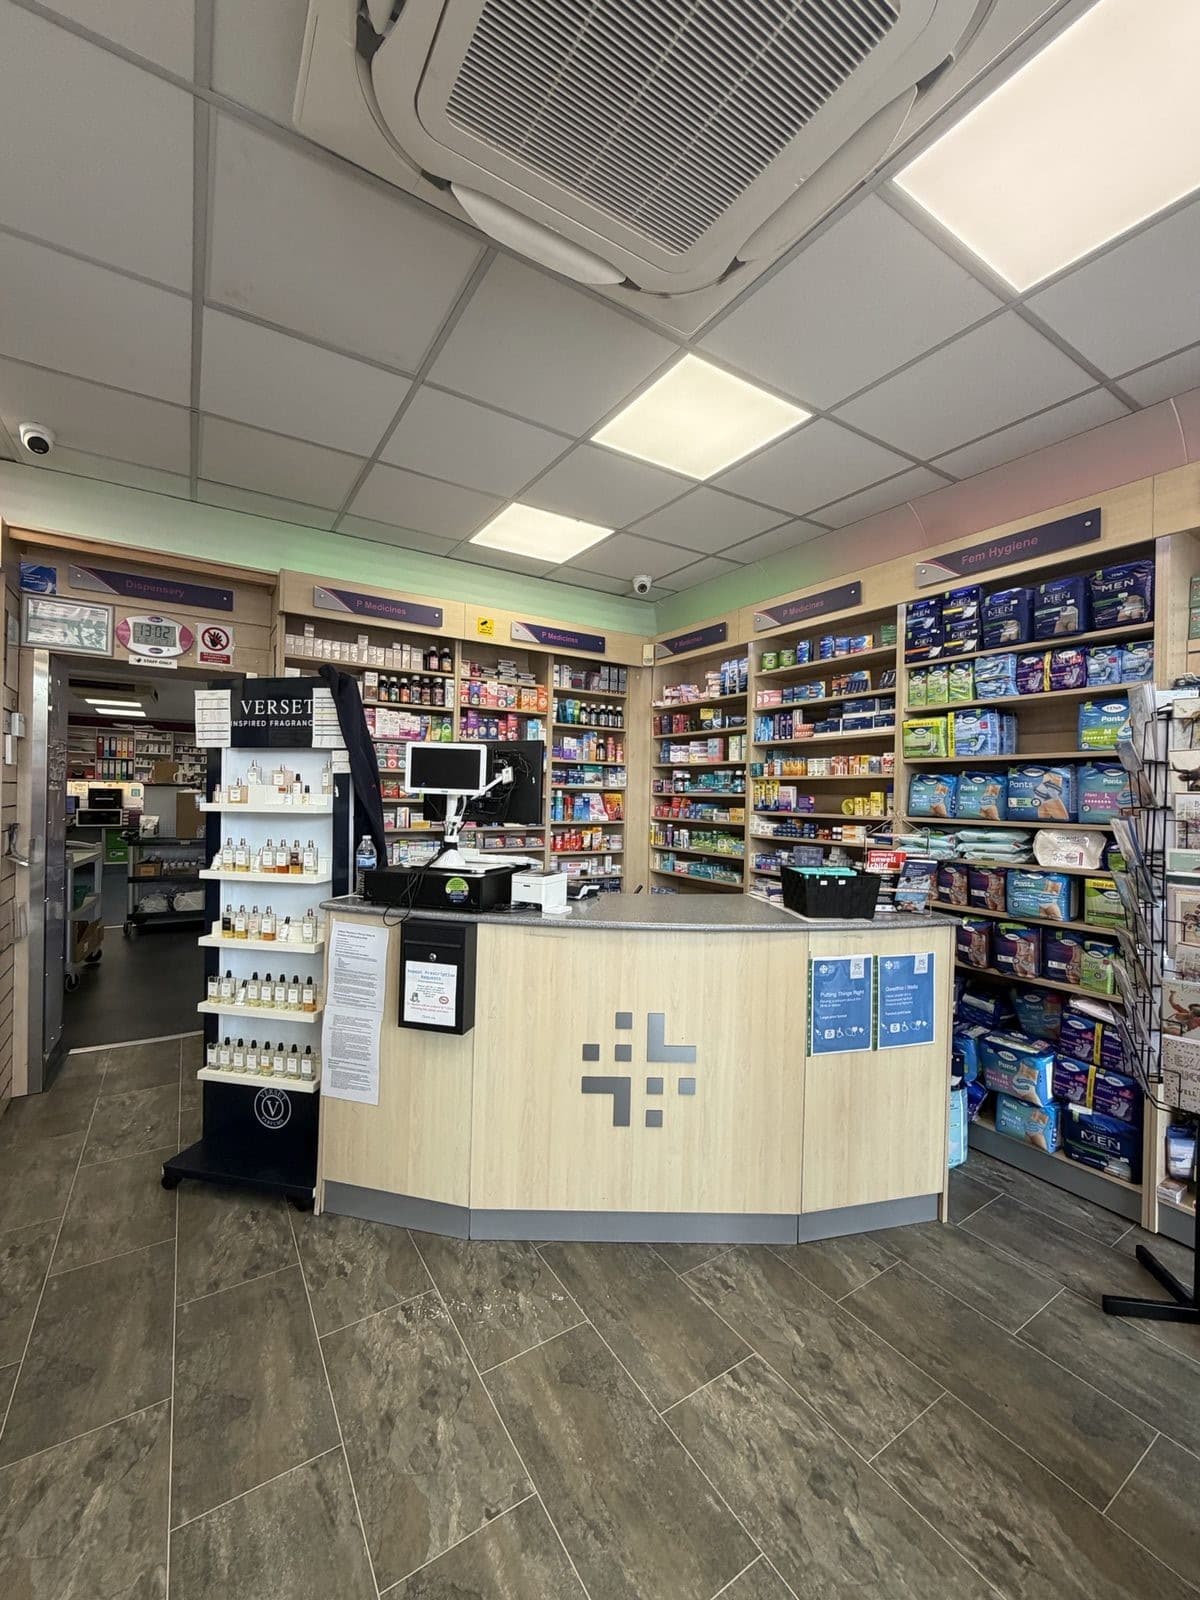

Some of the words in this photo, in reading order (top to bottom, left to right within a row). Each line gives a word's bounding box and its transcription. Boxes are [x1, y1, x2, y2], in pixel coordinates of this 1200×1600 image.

[961, 552, 985, 565] Fem
[988, 537, 1039, 558] Hygiene
[1101, 578, 1134, 592] MEN
[1043, 592, 1071, 604] MEN
[356, 599, 363, 607] P
[364, 600, 407, 615] Medicines
[782, 609, 788, 617] P
[788, 600, 825, 616] Medicines
[987, 605, 1014, 617] MEN
[541, 631, 547, 639] P
[547, 632, 579, 644] Medicines
[1009, 780, 1033, 788] Pants
[266, 1100, 279, 1117] V
[1080, 1130, 1121, 1151] MEN
